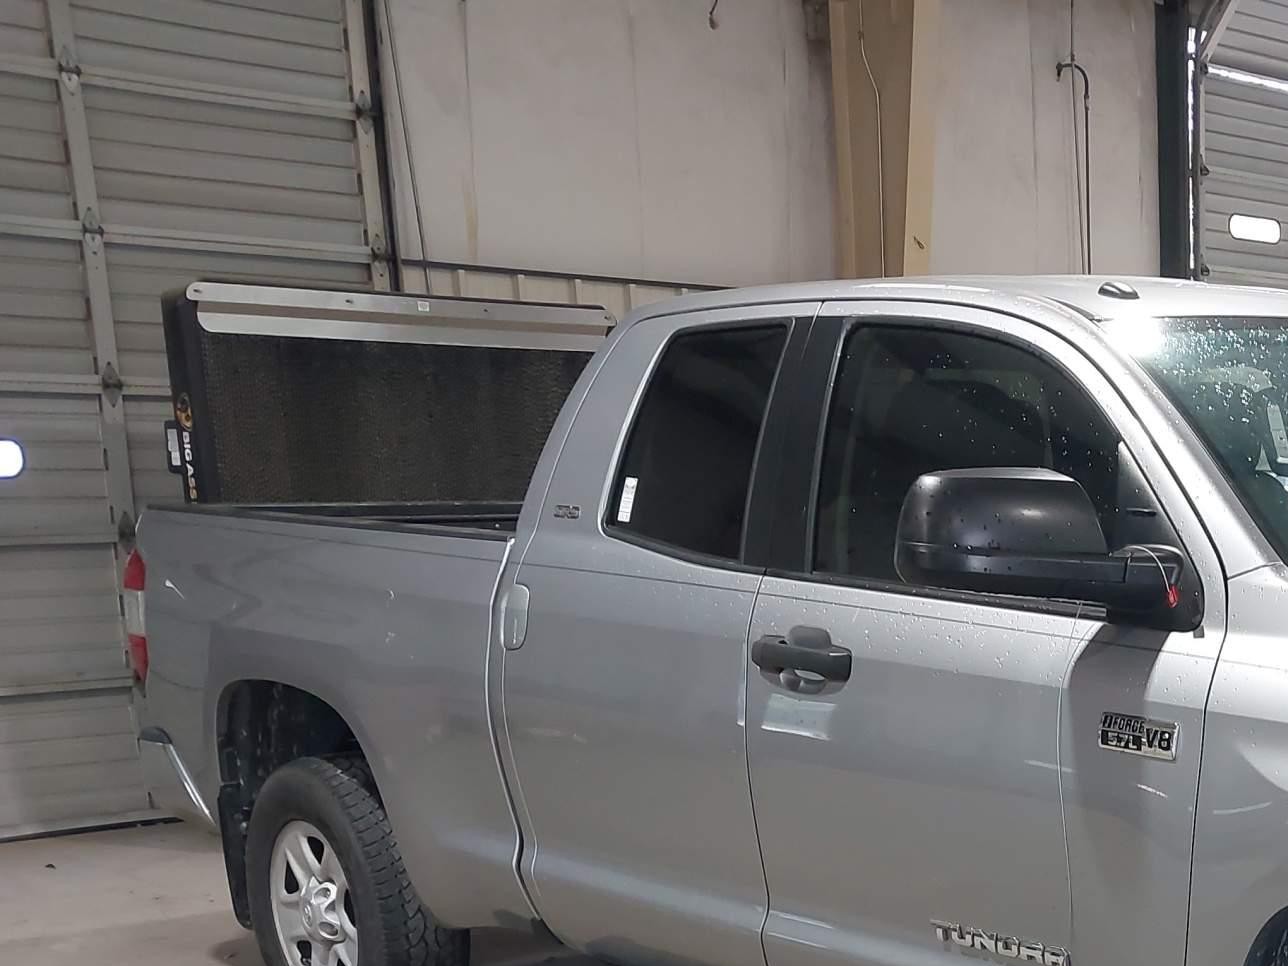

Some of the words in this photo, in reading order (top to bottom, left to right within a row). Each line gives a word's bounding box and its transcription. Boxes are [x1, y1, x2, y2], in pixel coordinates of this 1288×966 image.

[182, 431, 193, 462] BIG
[186, 462, 198, 500] ASS
[1145, 727, 1172, 752] V8
